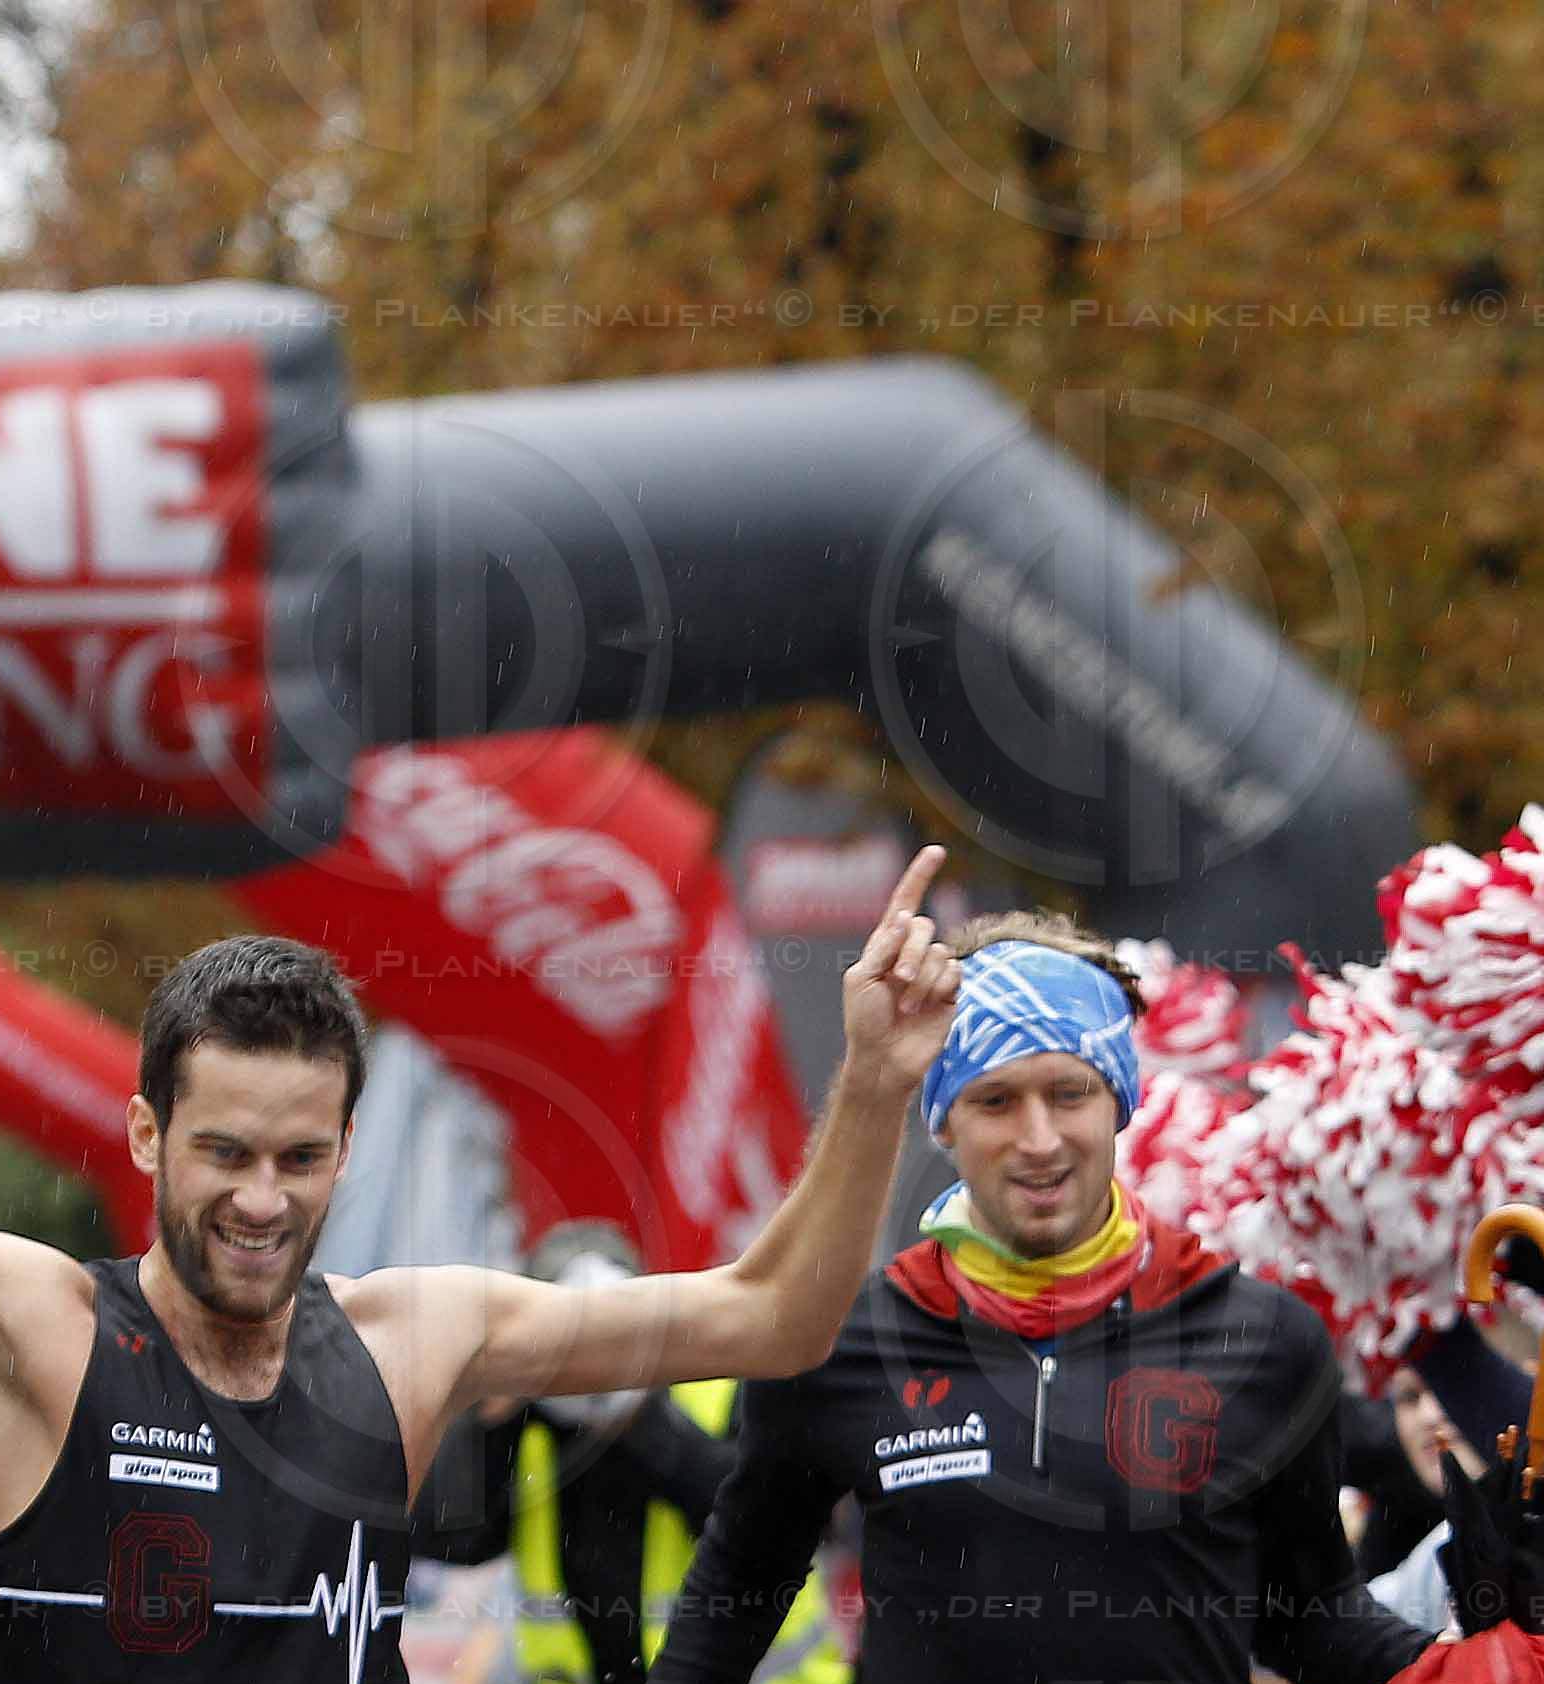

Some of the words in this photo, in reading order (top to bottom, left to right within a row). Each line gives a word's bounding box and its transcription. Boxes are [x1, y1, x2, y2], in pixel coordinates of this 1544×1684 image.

[110, 1422, 216, 1456] GARMIN
[874, 1412, 988, 1458] GARMIN
[1105, 1367, 1224, 1495] G
[123, 1459, 162, 1477] giga
[167, 1463, 215, 1484] sport
[107, 1512, 213, 1655] G
